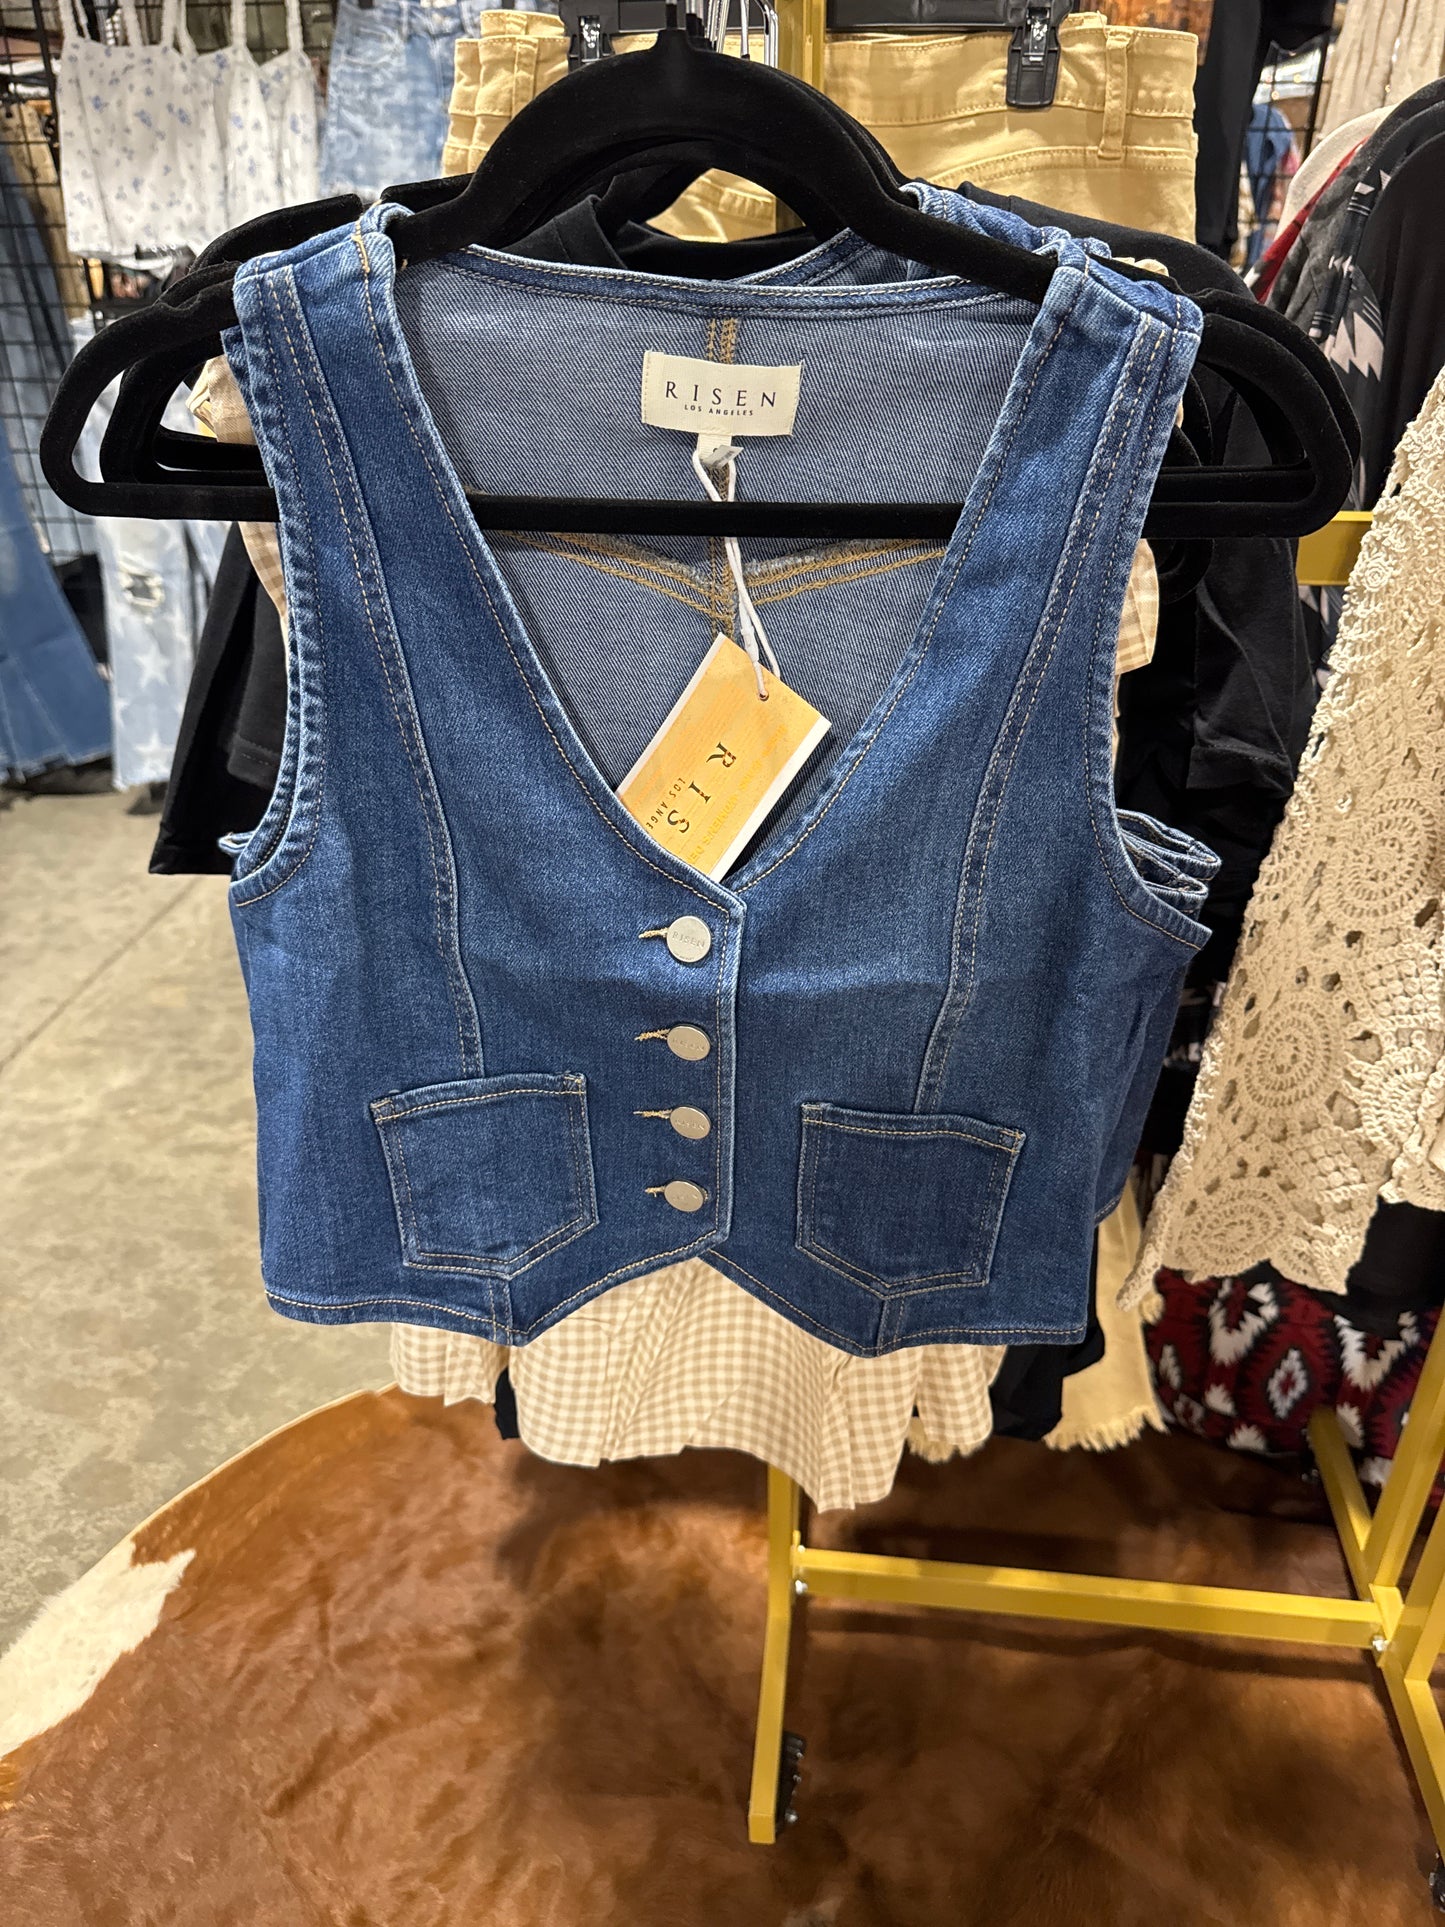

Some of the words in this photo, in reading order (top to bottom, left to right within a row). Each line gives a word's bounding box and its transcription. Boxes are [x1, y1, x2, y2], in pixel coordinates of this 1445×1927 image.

[665, 381, 777, 408] RISEN
[684, 404, 703, 413] LOS
[708, 408, 754, 417] ANGELES
[668, 777, 685, 798] LOS
[672, 931, 705, 947] RISEN
